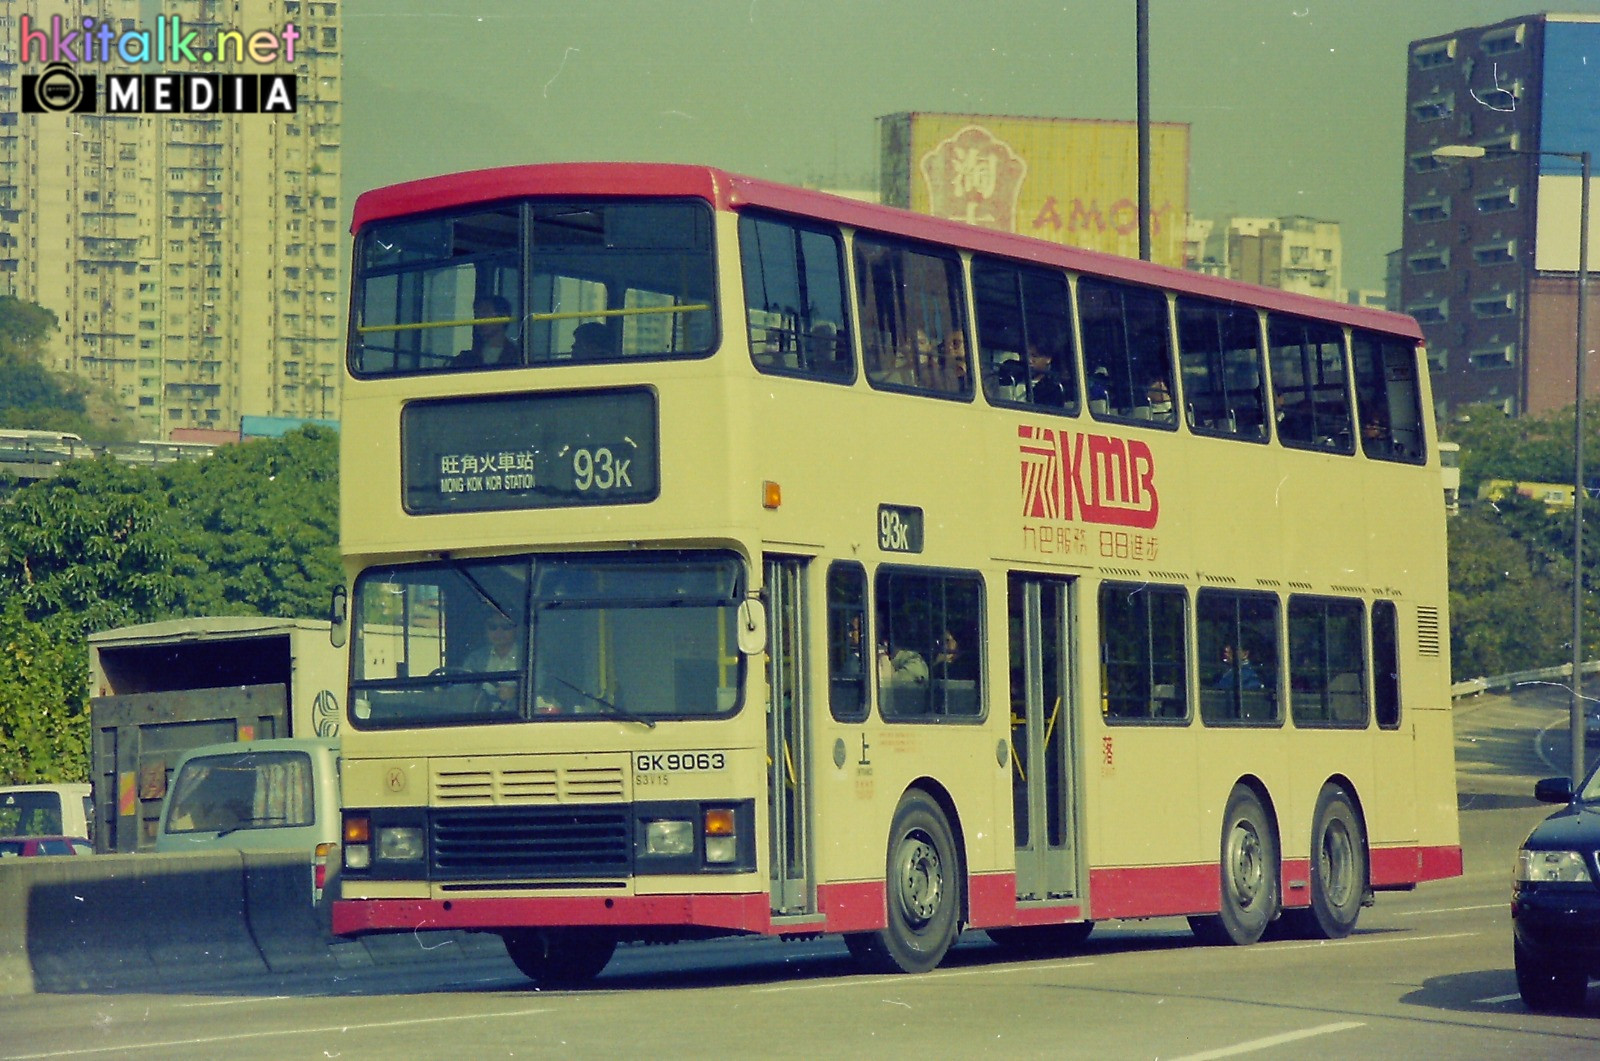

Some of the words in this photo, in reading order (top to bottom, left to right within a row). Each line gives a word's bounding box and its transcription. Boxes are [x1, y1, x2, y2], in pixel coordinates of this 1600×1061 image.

[1031, 196, 1173, 236] AMOY
[441, 452, 534, 474] 旺角火車站
[573, 448, 632, 491] 93K
[1059, 430, 1159, 530] KMB
[441, 477, 464, 493] MONG
[467, 476, 483, 492] KOK
[504, 474, 535, 490] STATION
[881, 510, 908, 550] 93K
[1099, 530, 1159, 561] 日日進步
[637, 754, 725, 771] GK9063
